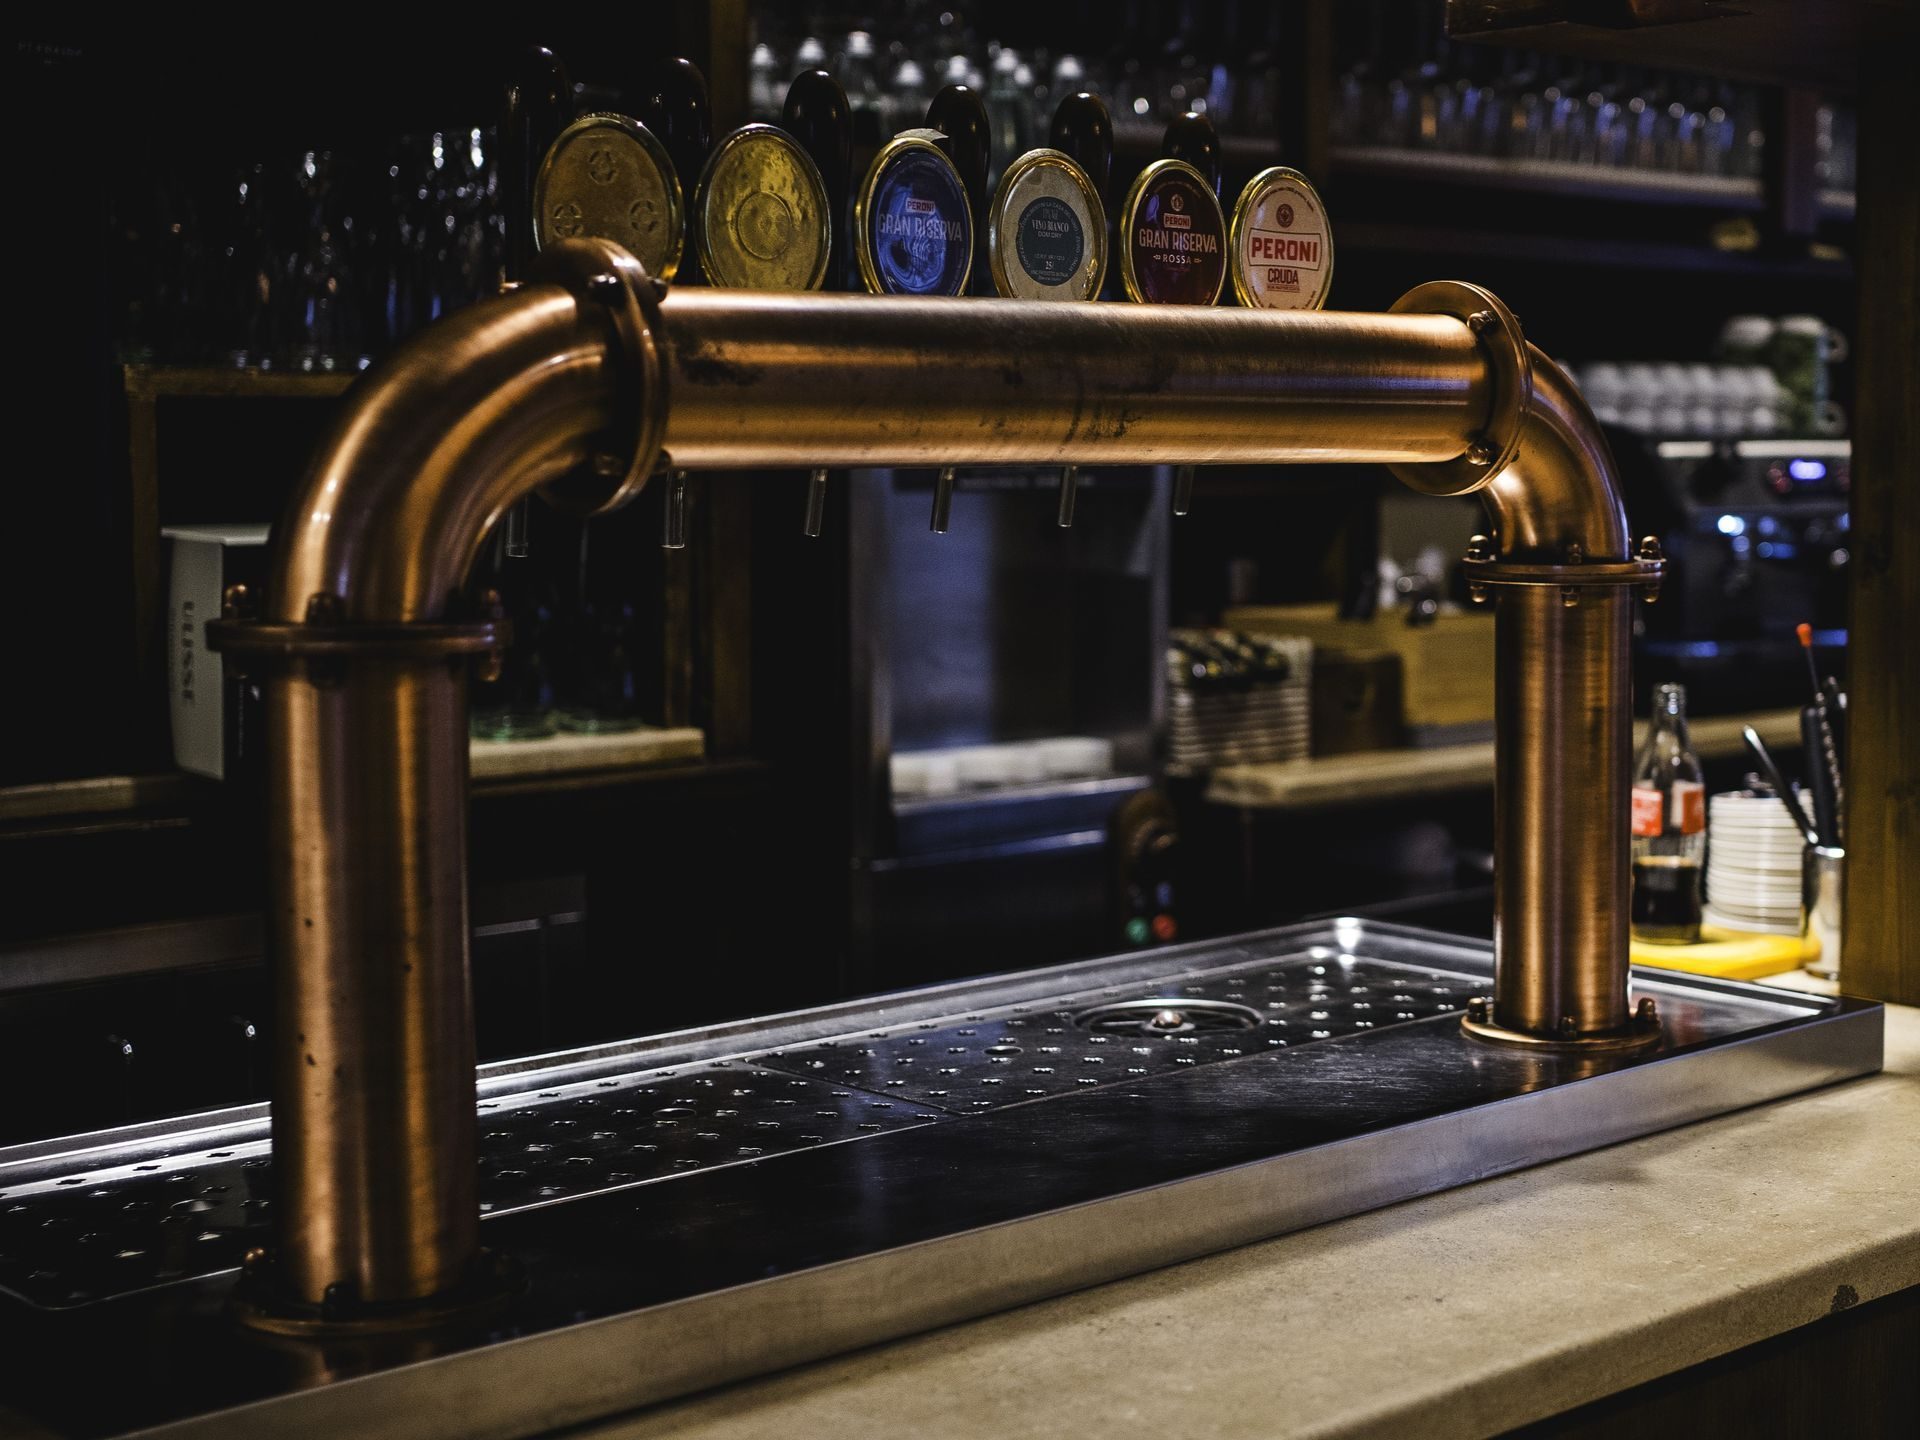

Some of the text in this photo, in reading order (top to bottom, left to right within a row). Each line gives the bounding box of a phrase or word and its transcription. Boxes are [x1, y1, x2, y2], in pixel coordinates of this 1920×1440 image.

[907, 201, 935, 212] PERONI
[879, 213, 963, 242] GRAN RISERVA
[1031, 219, 1047, 230] VINO
[1165, 215, 1190, 227] PERONI
[1139, 228, 1218, 253] GRAN RISERVA
[1251, 237, 1318, 262] PERONI
[1162, 254, 1192, 264] ROSSA
[1267, 268, 1300, 285] CRUDA
